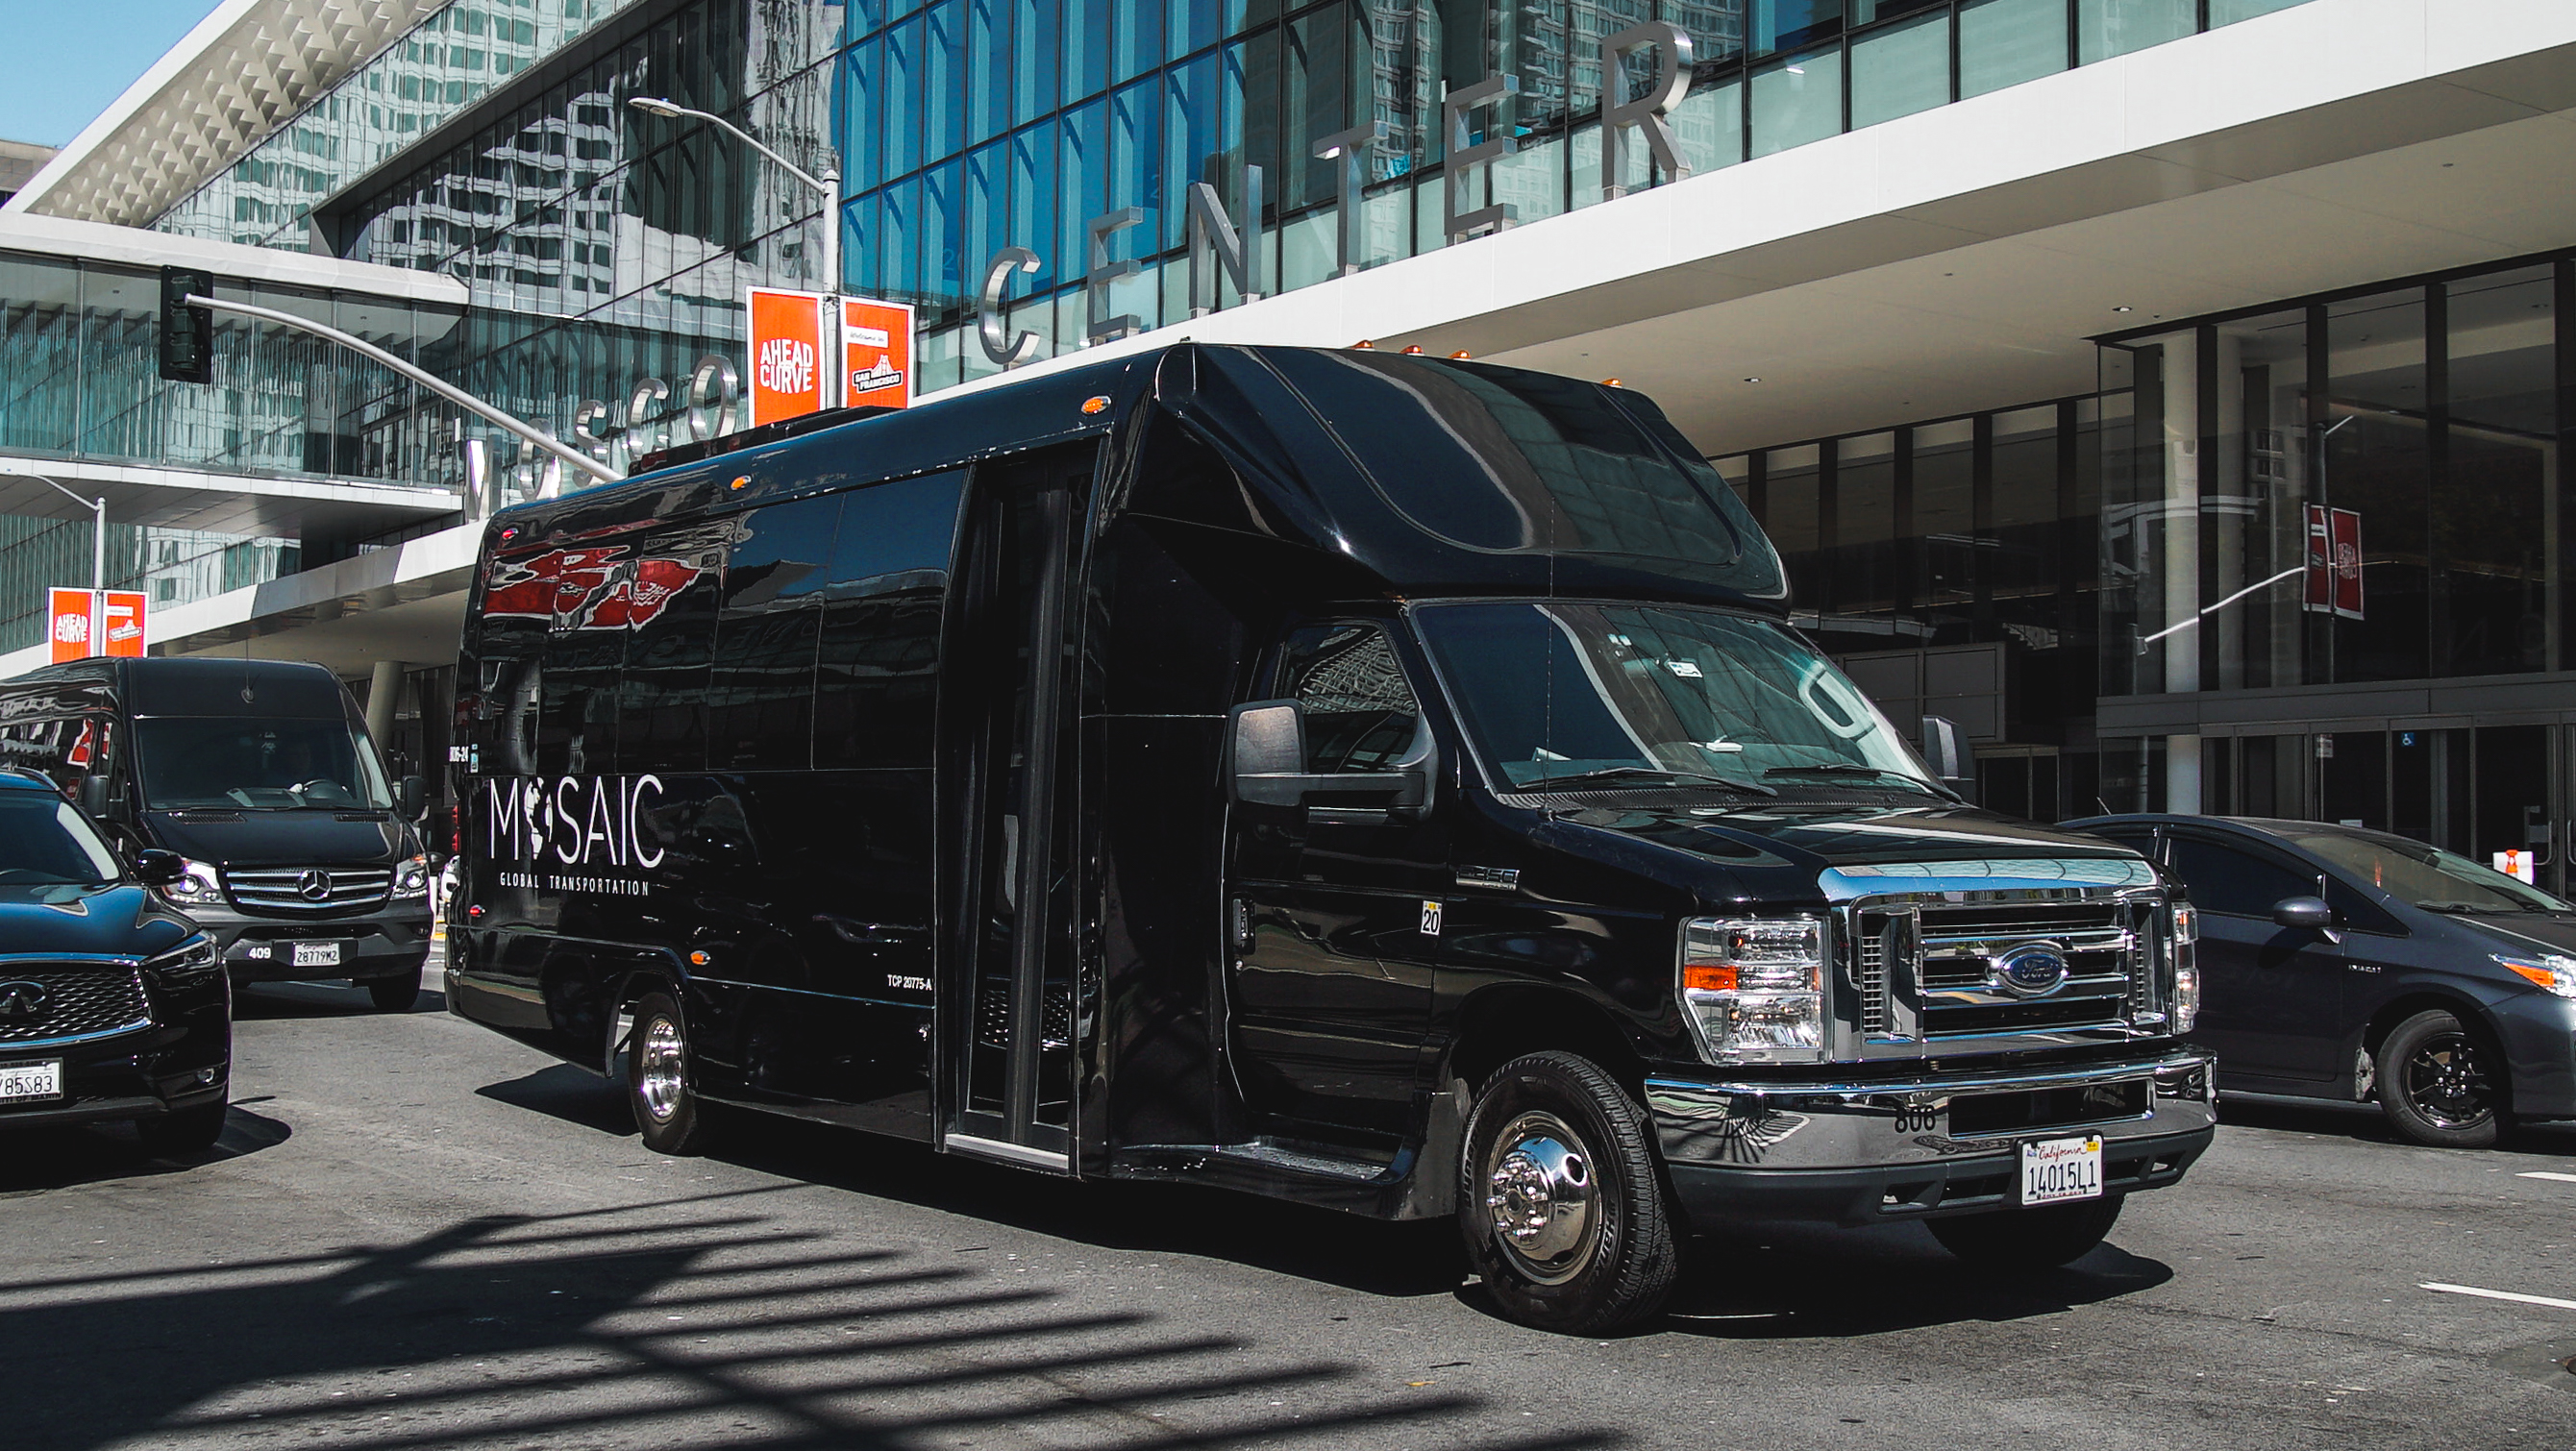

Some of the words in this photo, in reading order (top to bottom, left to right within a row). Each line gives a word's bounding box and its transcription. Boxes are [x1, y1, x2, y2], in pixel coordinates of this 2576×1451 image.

[978, 19, 1694, 370] CENTER
[759, 338, 814, 368] AHEAD
[759, 365, 813, 395] CURVE
[55, 613, 88, 630] AHEAD
[55, 627, 87, 644] CURVE
[500, 872, 539, 888] GLOBAL
[549, 874, 649, 897] TRANSPORTATION
[1423, 909, 1439, 933] 20
[248, 947, 271, 959] 409
[297, 949, 337, 964] 28779M2
[887, 973, 903, 988] TCP
[2028, 1159, 2096, 1196] 14015L1
